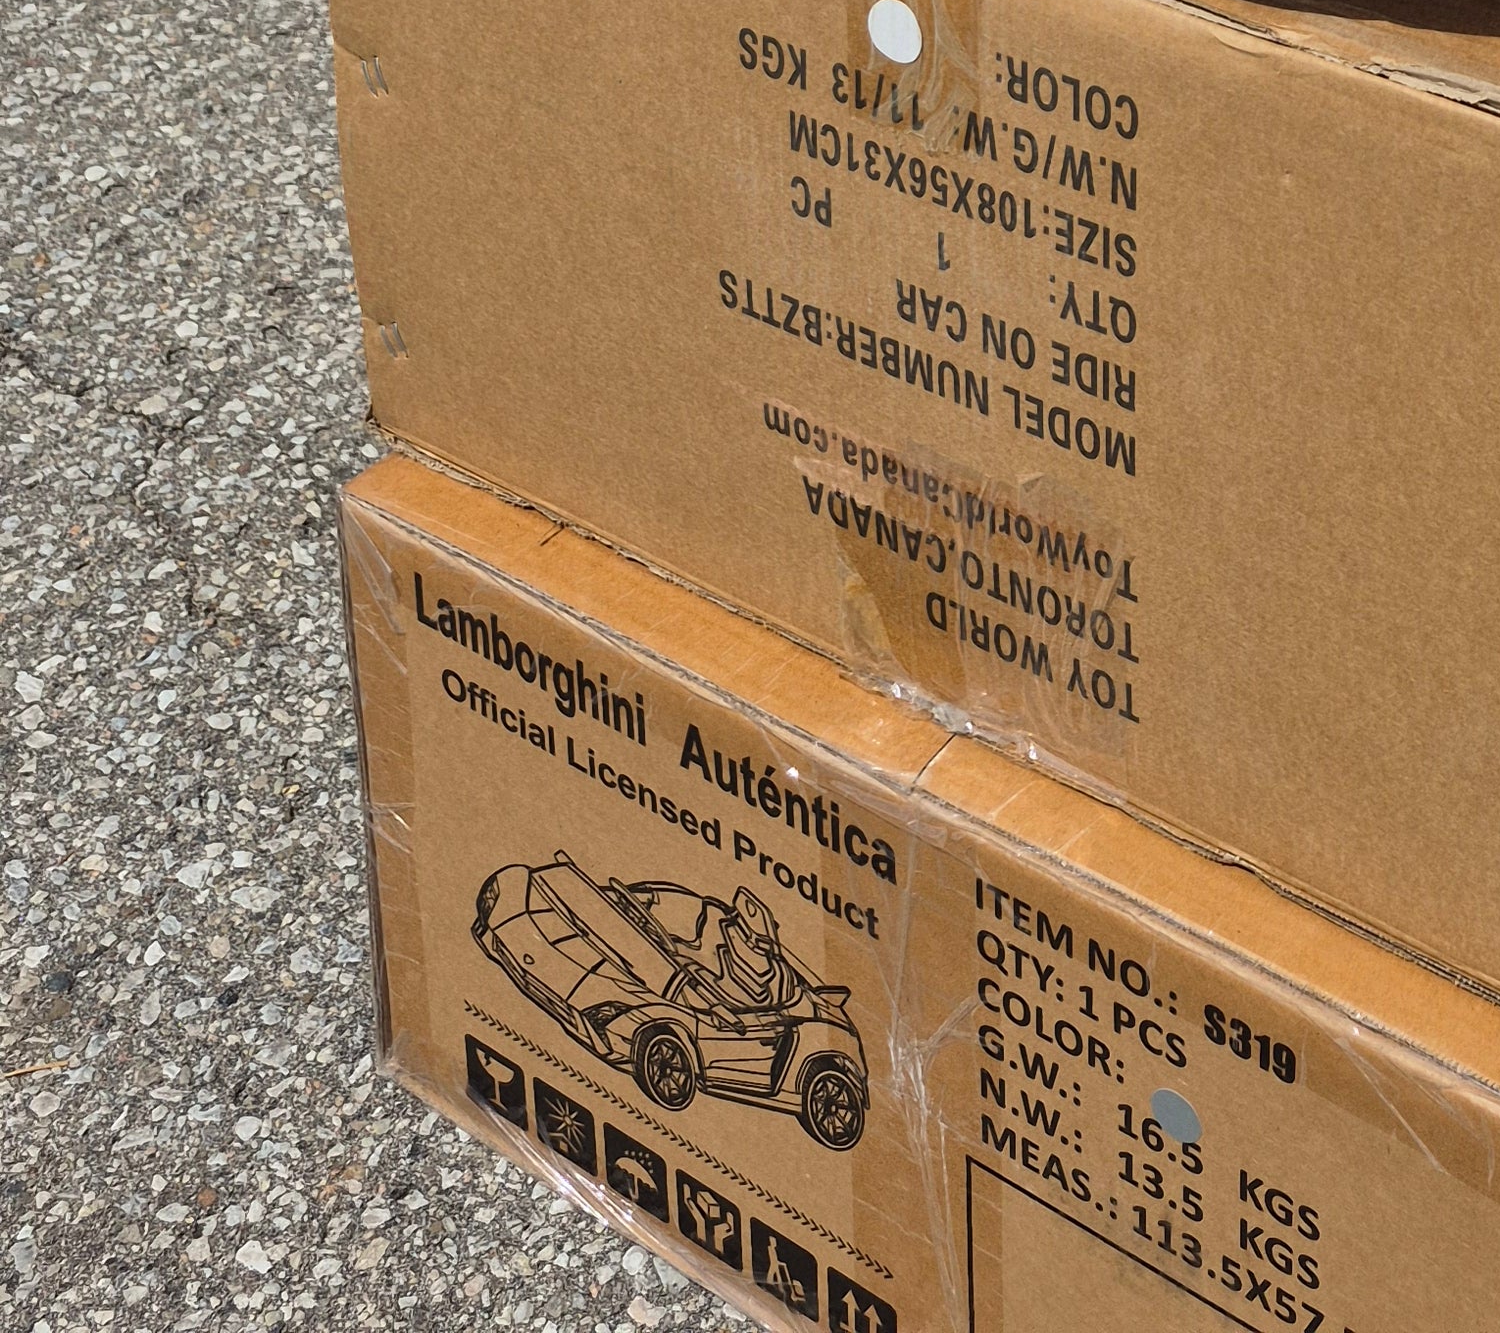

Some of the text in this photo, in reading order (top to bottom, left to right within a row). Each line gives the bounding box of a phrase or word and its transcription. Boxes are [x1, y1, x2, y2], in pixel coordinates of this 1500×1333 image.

[738, 28, 808, 88] KGS
[832, 62, 926, 132] 11/13
[993, 50, 1139, 139] COLOR:
[789, 111, 1137, 275] SIZE:108X56X31CM
[790, 177, 1137, 343] QTY: 1 PC
[718, 269, 1136, 475] MODEL NUMBER:BZTTS
[896, 279, 1136, 411] RIDE ON CAR
[763, 404, 1139, 601] ToyWorldCanada.com
[802, 476, 1140, 663] TORONTO,CANADA
[413, 572, 898, 886] Lamborghini Auténtica
[924, 592, 1140, 723] TOY WORLD
[442, 668, 882, 939] Official Licensed Product
[975, 877, 1298, 1085] ITEM NO.: S319
[977, 931, 1188, 1070] QTY: 1 PCS
[977, 978, 1126, 1085] COLOR:
[979, 1025, 1084, 1107] G.W.:
[1239, 1170, 1323, 1242] KGS
[980, 1113, 1119, 1222] MEAS.:
[980, 1068, 1323, 1290] N.W.: 13.5 KGS
